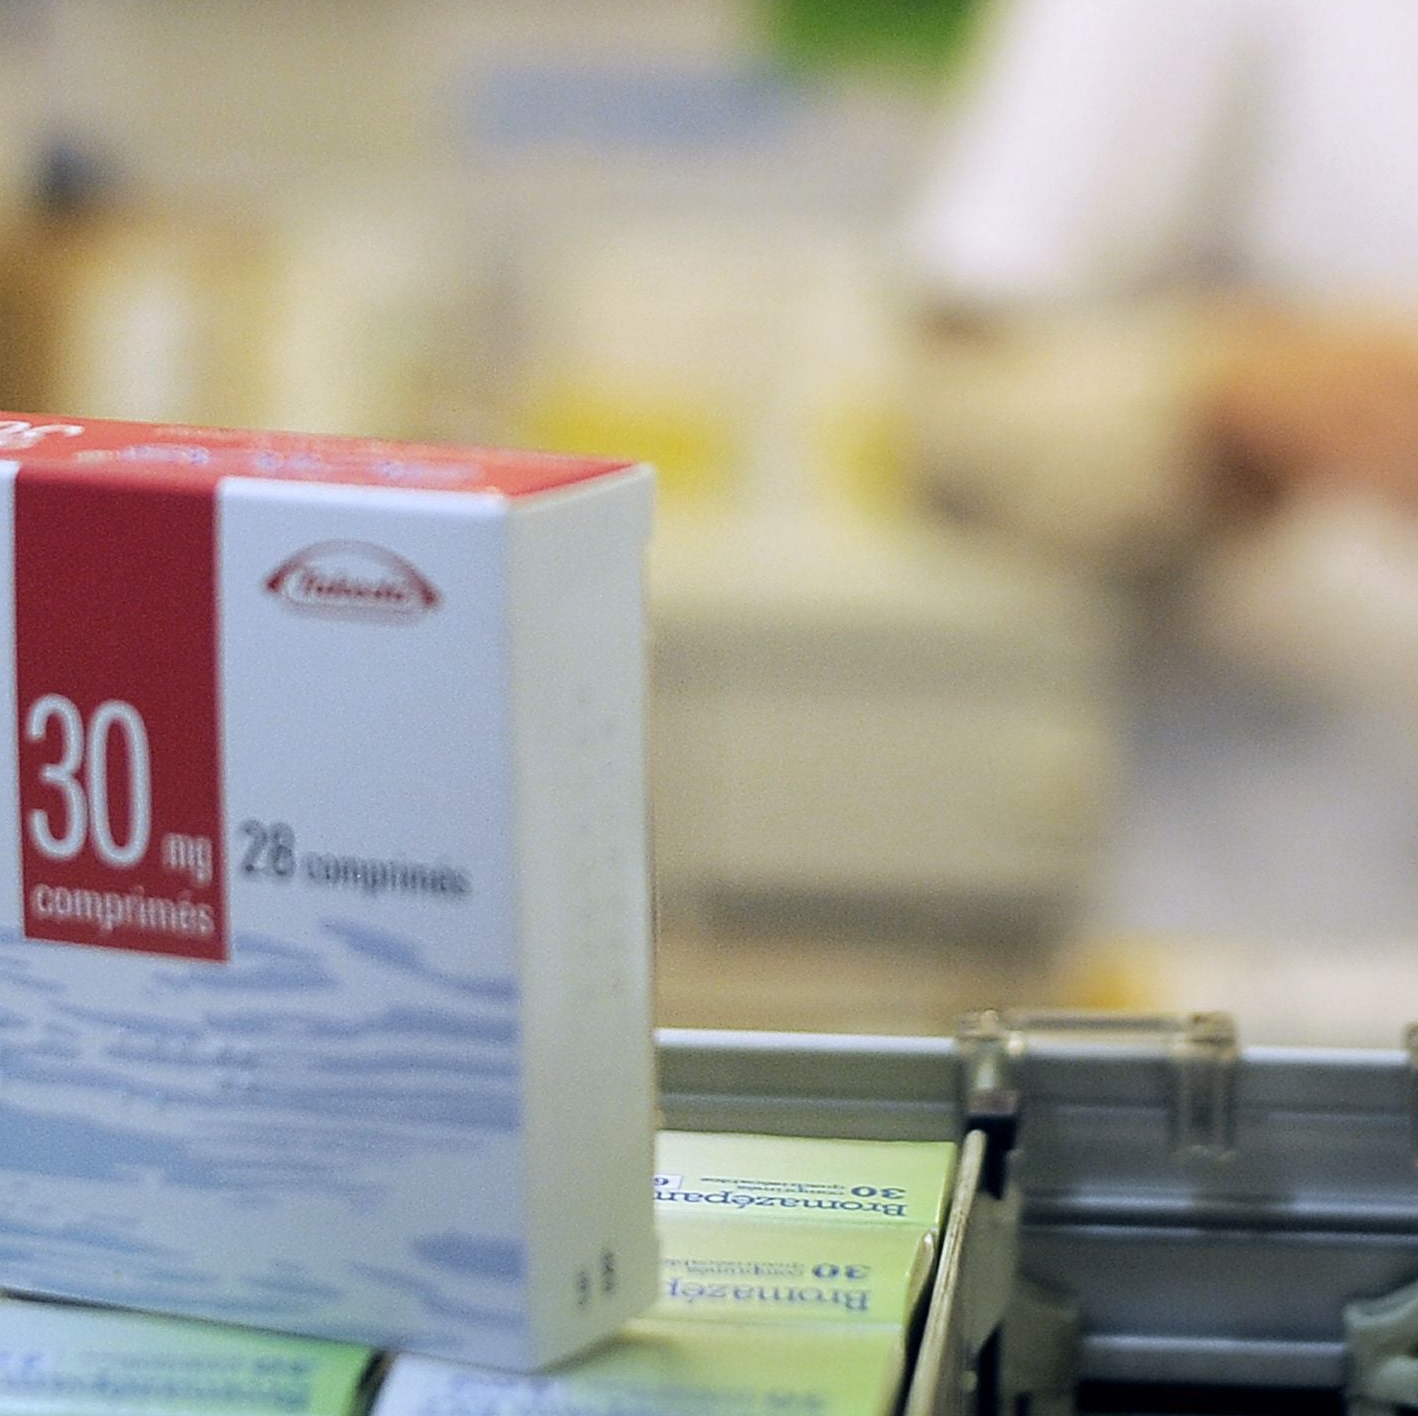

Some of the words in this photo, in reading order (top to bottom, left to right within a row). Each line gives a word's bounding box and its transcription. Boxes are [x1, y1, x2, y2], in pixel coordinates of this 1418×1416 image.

[27, 693, 153, 868] 30
[162, 832, 214, 885] mg
[238, 818, 296, 879] 28
[302, 850, 473, 902] comprimés
[33, 884, 216, 937] comprimés
[851, 1185, 906, 1200] 30
[665, 1277, 870, 1312] Bromazép
[811, 1263, 871, 1280] 30
